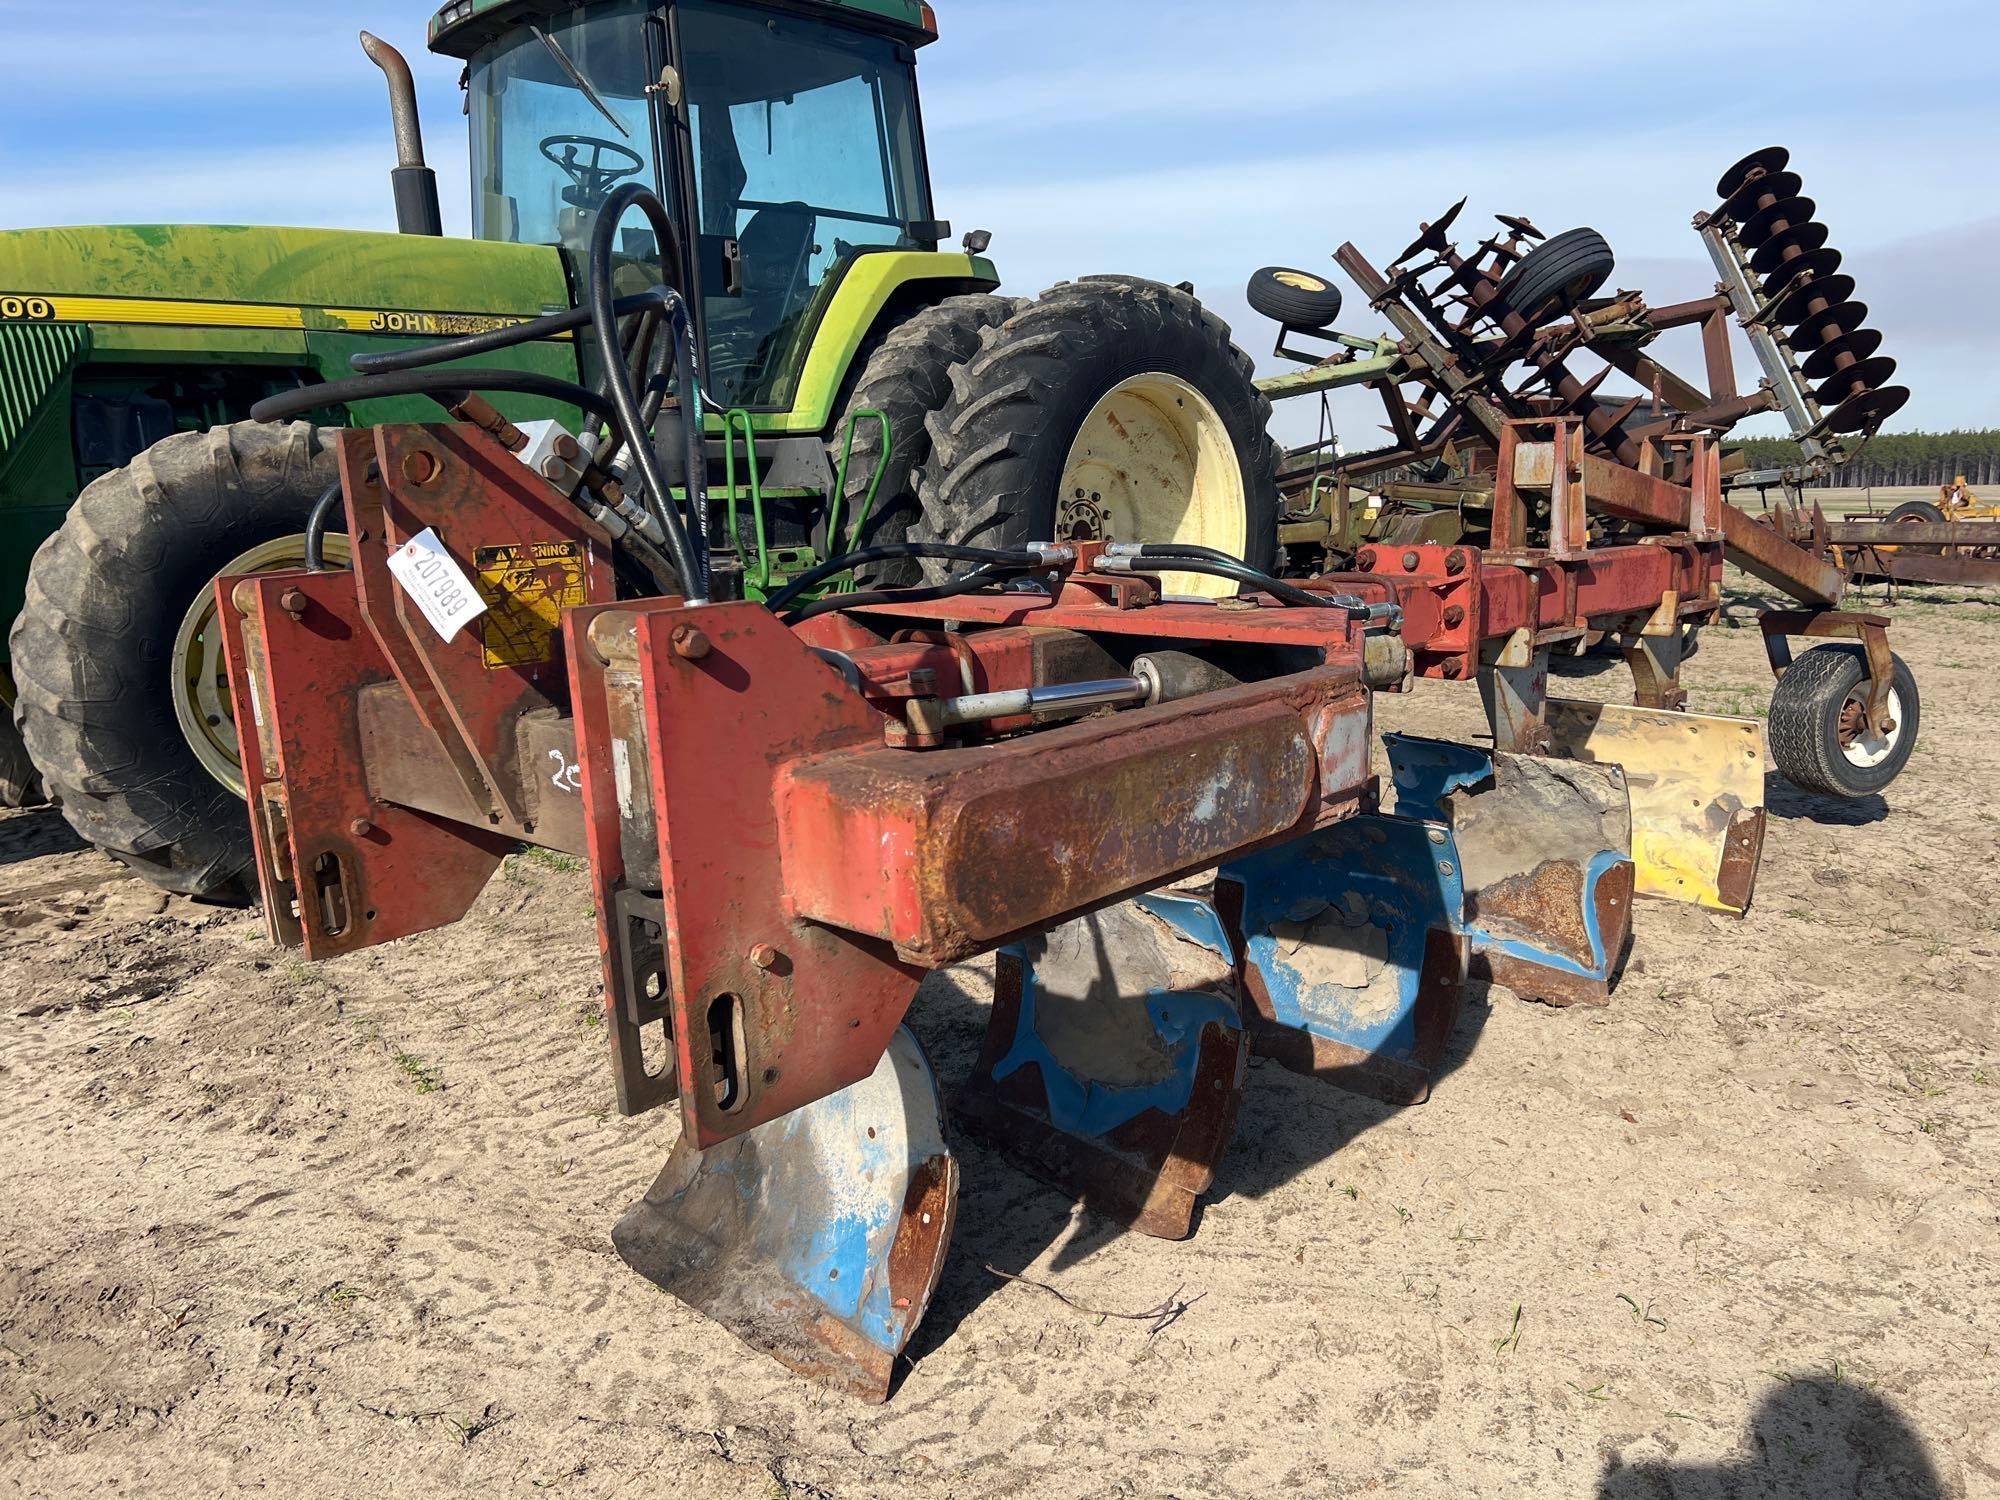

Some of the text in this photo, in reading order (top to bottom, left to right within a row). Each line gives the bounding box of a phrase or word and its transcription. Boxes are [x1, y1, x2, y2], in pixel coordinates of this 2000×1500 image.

[370, 312, 437, 331] JOHN
[508, 544, 570, 559] WRNING
[413, 550, 468, 617] 207989
